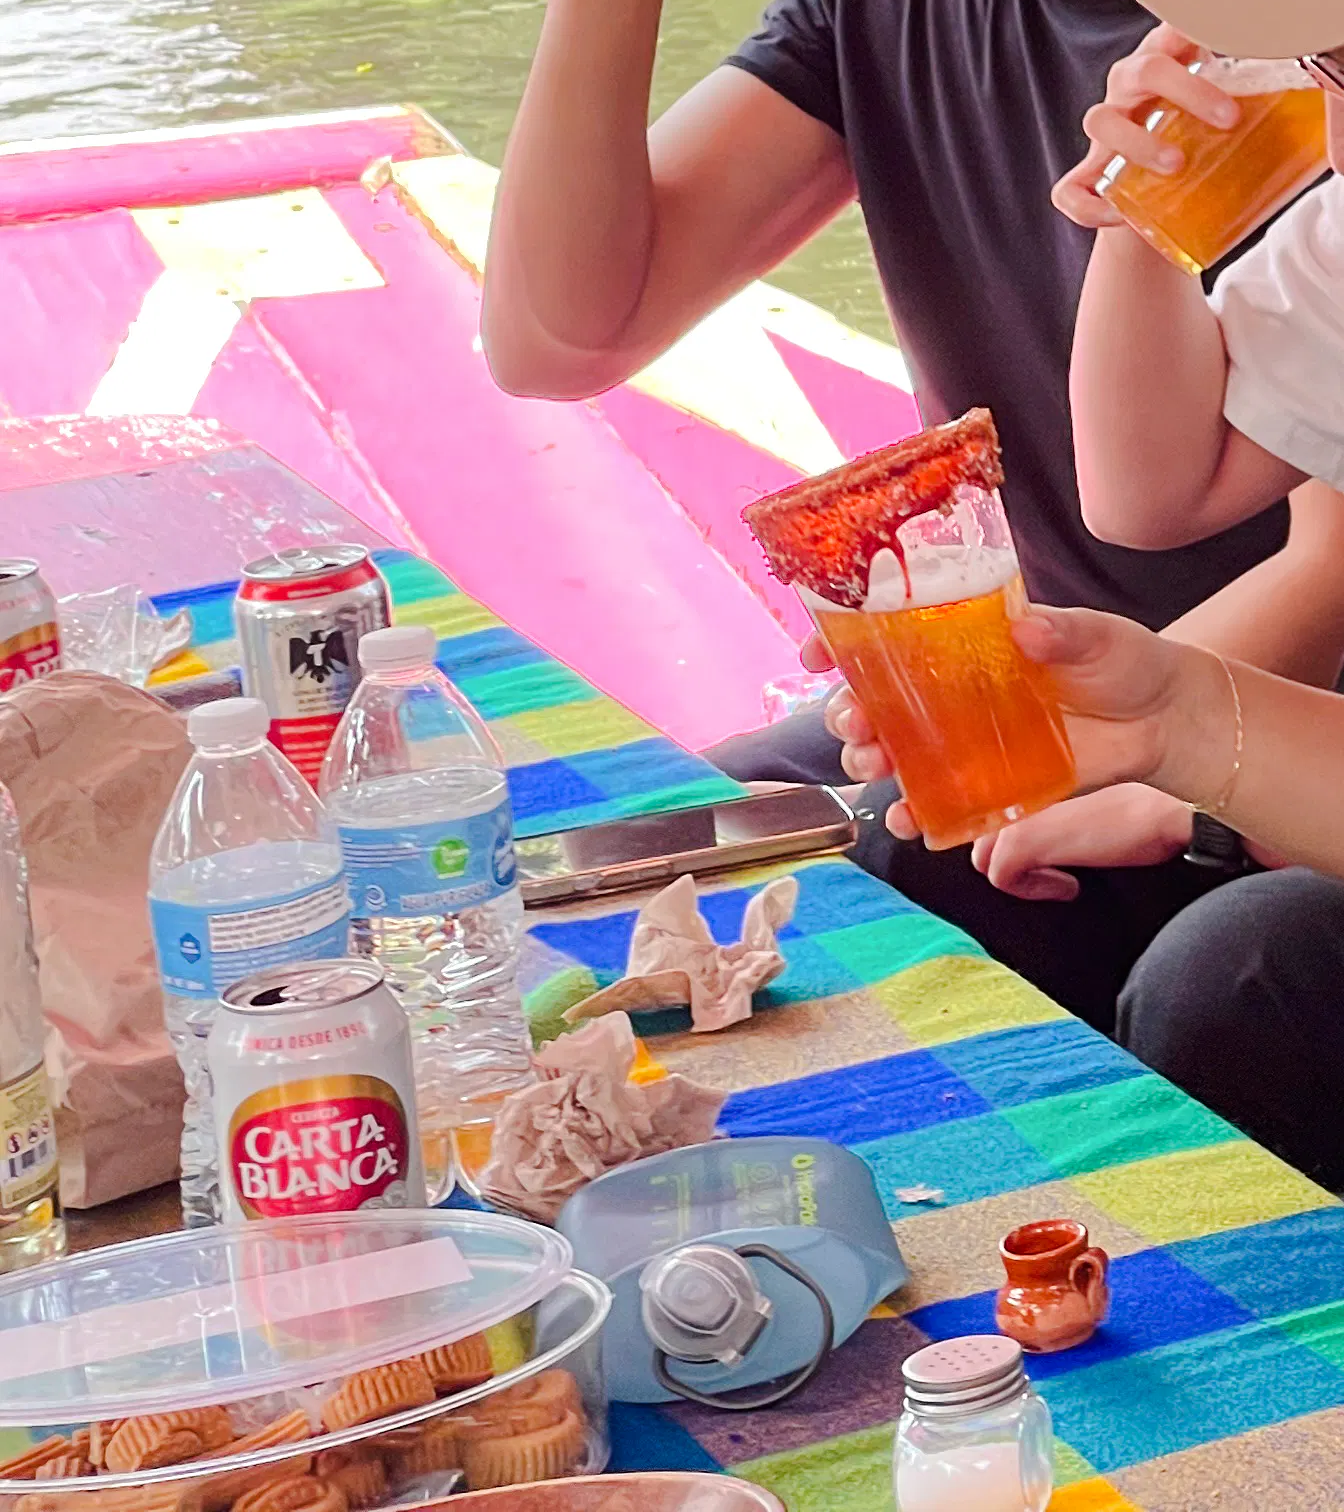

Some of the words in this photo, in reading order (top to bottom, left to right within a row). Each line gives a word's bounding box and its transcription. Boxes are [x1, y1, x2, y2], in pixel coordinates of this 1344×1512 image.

[288, 1030, 334, 1050] DESDE
[244, 1113, 387, 1165] CARTA
[238, 1147, 399, 1201] BLANCA
